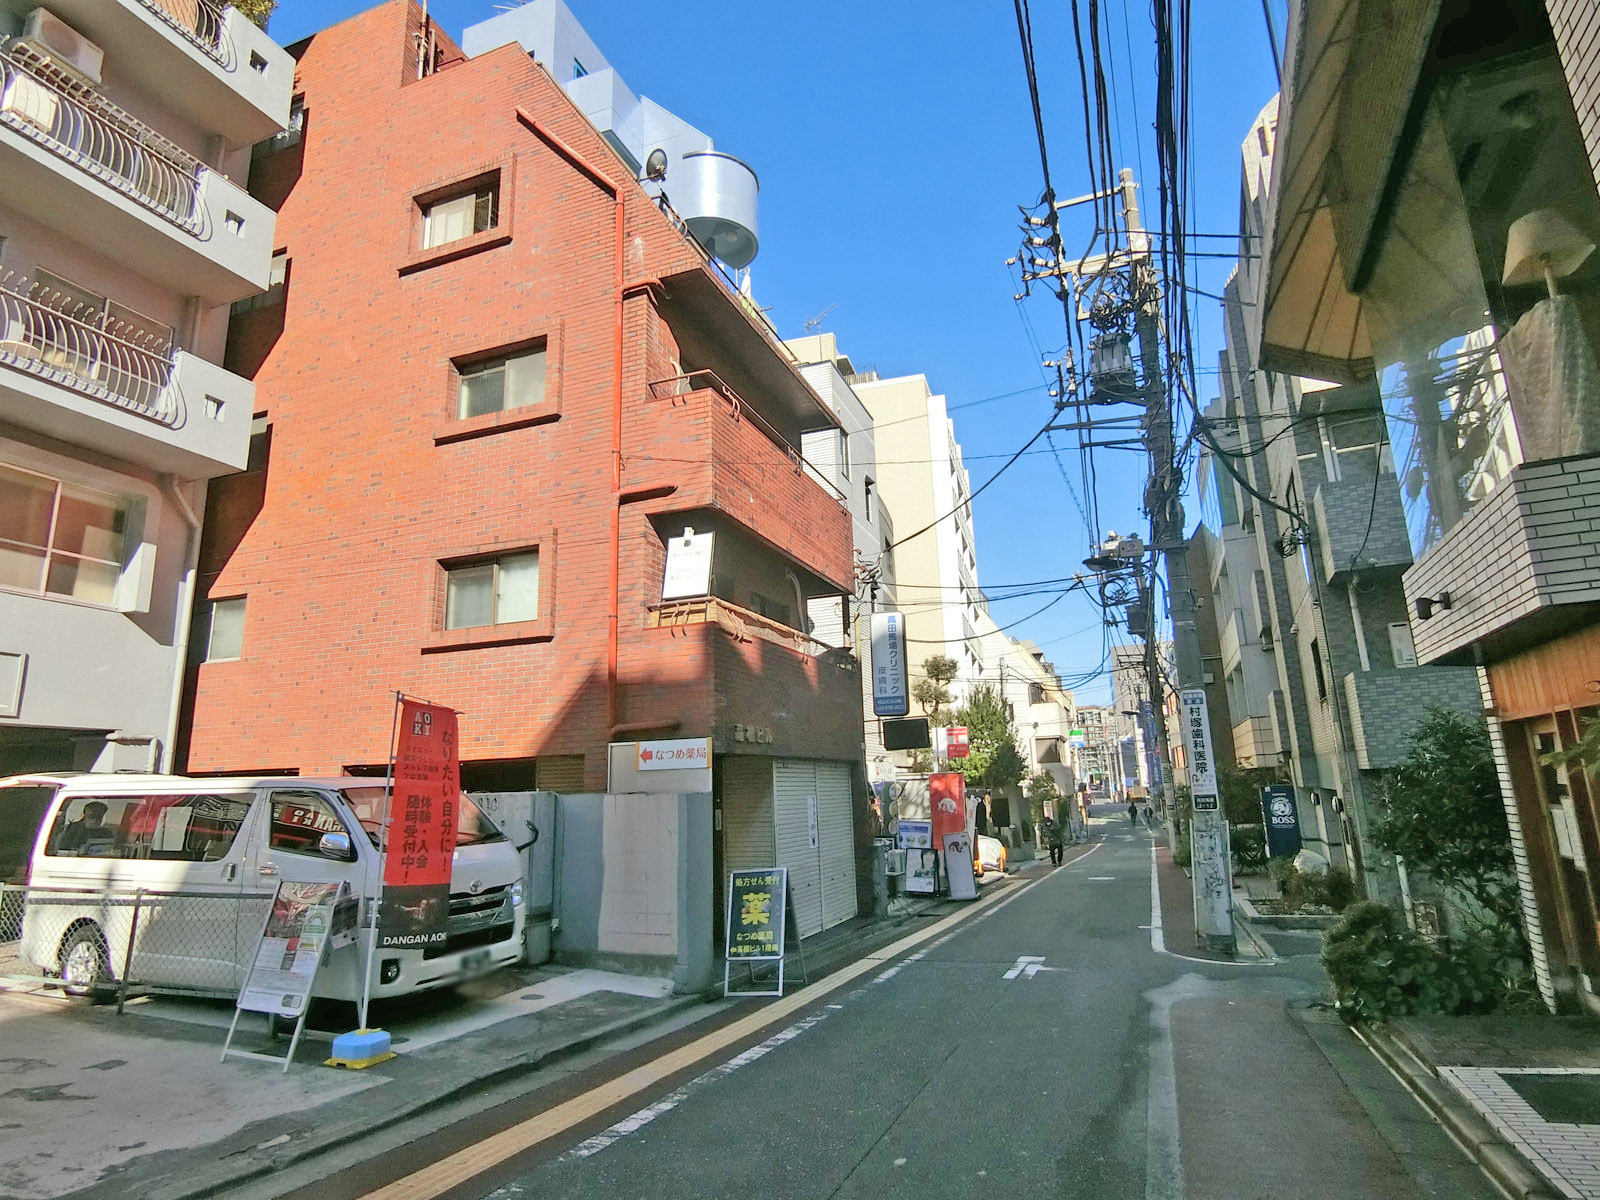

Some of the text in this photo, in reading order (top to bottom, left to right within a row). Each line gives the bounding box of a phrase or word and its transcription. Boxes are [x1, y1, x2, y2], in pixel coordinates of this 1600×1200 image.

[887, 615, 899, 694] 高田馬場クリニック
[878, 666, 887, 695] 皮膚科
[1189, 706, 1208, 774] 村塚歯科医院
[655, 747, 707, 760] なつめ薬局
[1271, 816, 1296, 824] BOSS
[735, 875, 780, 887] 処方せん受付
[741, 892, 771, 925] 薬
[383, 934, 428, 945] DANGAN
[736, 930, 774, 941] なつめ薬局
